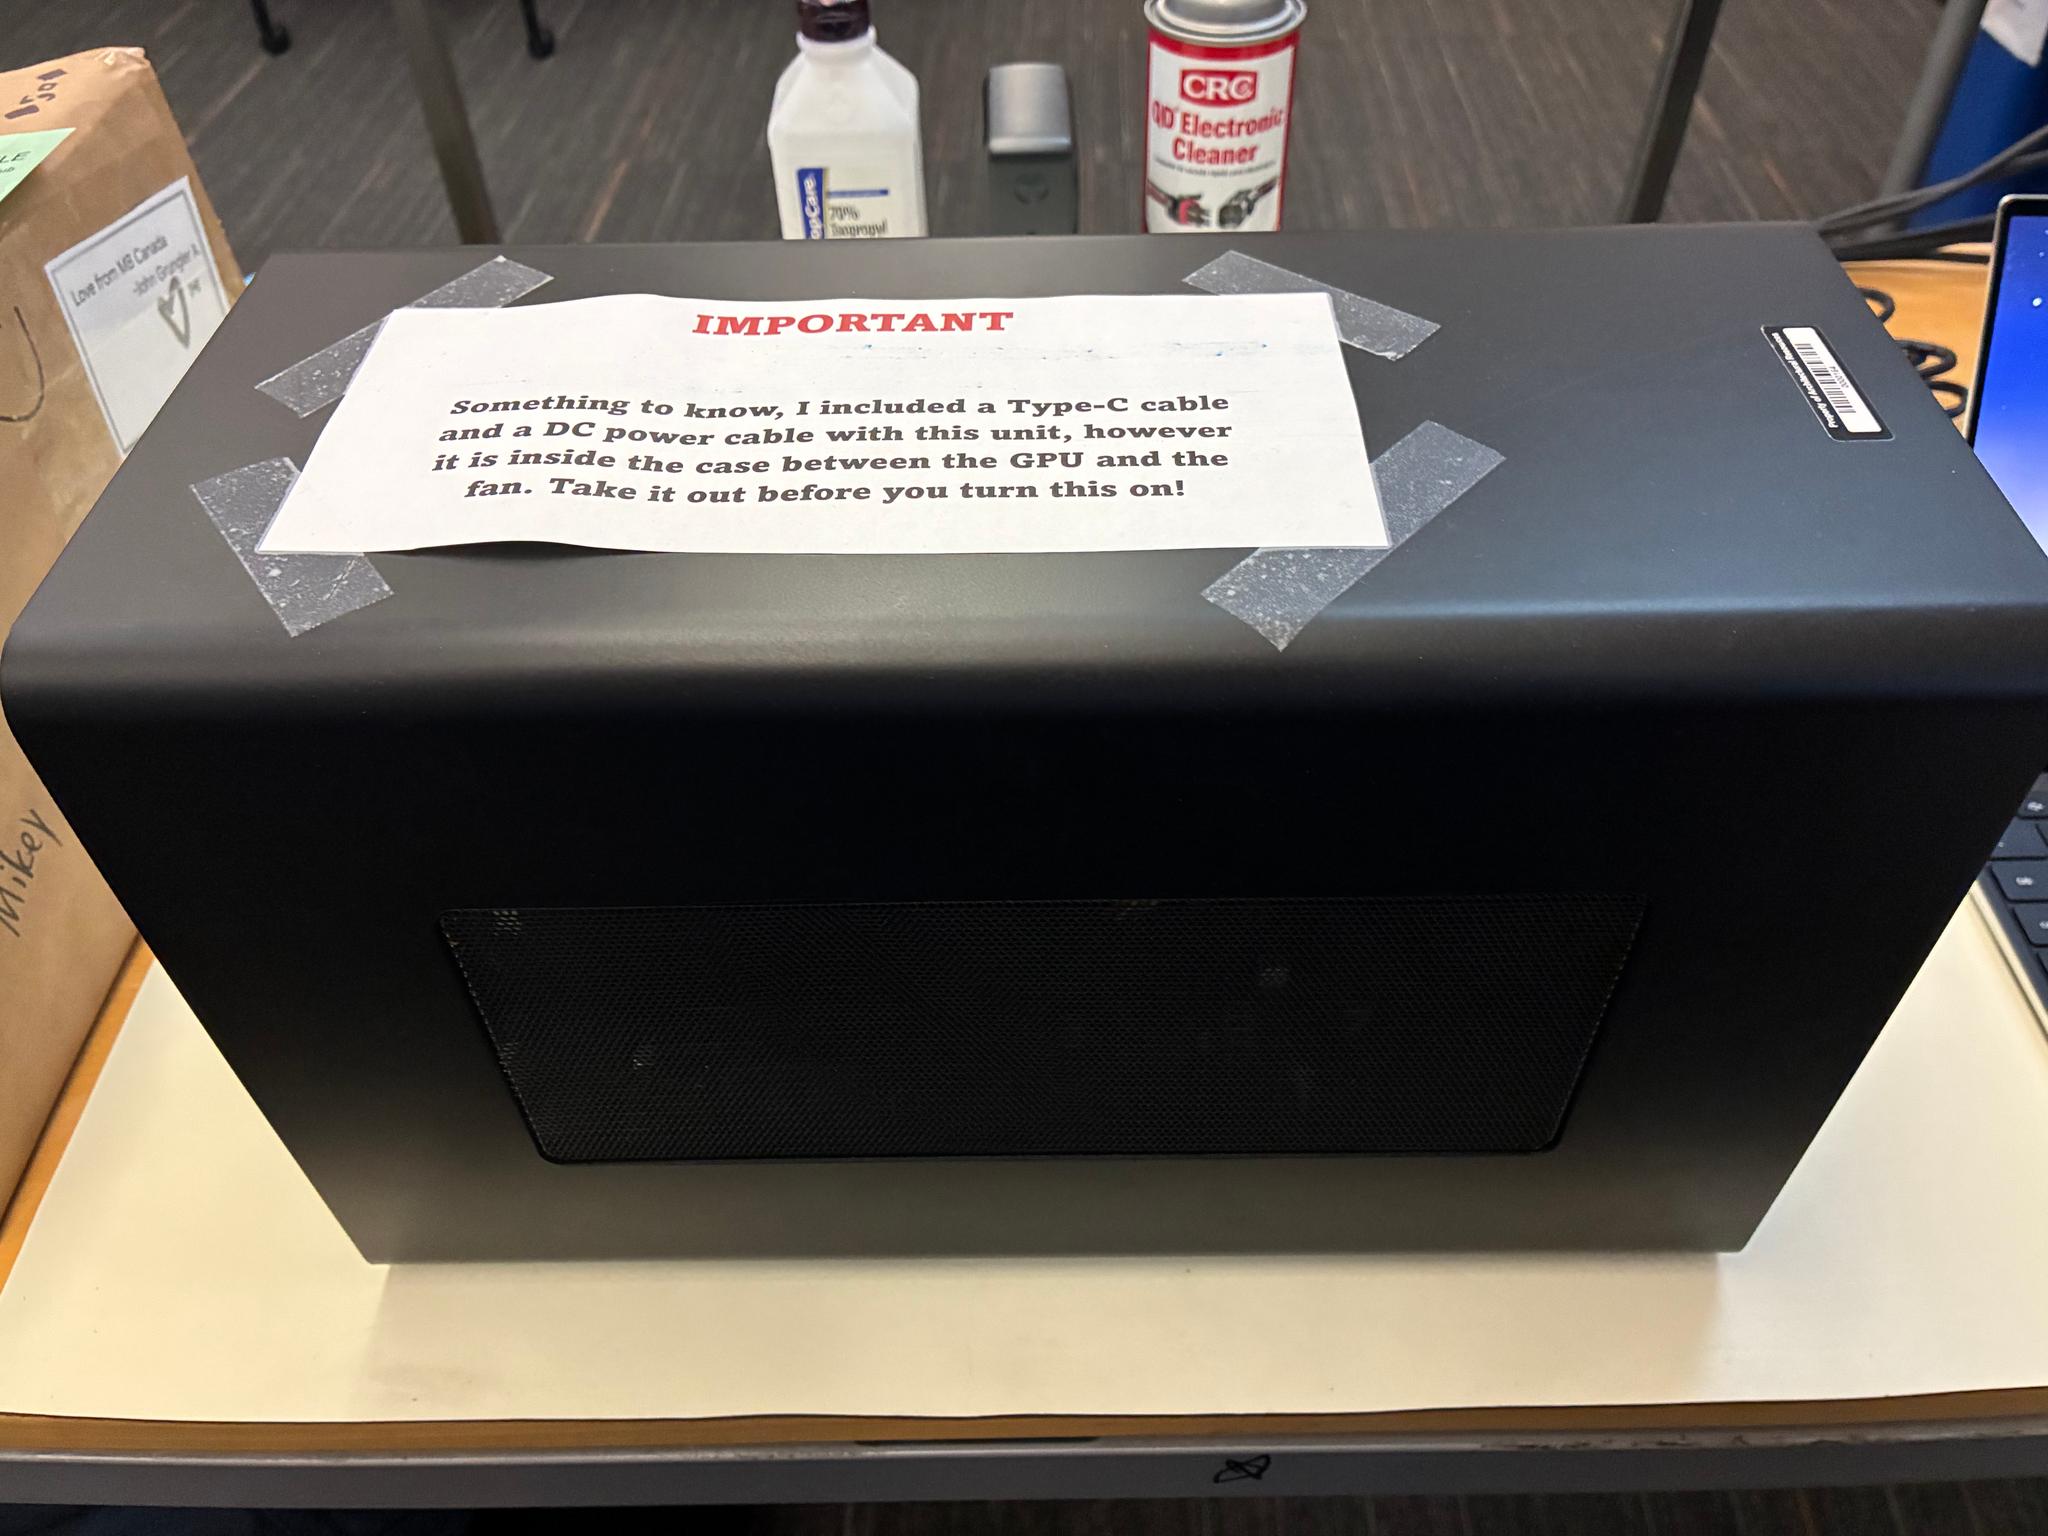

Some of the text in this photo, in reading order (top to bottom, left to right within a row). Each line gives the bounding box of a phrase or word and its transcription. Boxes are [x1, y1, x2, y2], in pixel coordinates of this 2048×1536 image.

[1183, 74, 1254, 100] CRC
[1181, 107, 1283, 138] Electronic
[1173, 138, 1258, 165] Cleaner
[70, 282, 97, 307] Love
[94, 268, 119, 290] from
[133, 235, 169, 265] Canada
[692, 312, 1014, 335] IMPORTANT
[450, 395, 1229, 420] Something to know, I included a Type-C cable
[438, 421, 1232, 446] and a DC power cable with this unit, however
[431, 449, 1228, 474] it is inside the case between the GPU and the
[464, 478, 1185, 504] fan. Take it out before you turn this on!
[0, 808, 63, 937] Mikey
